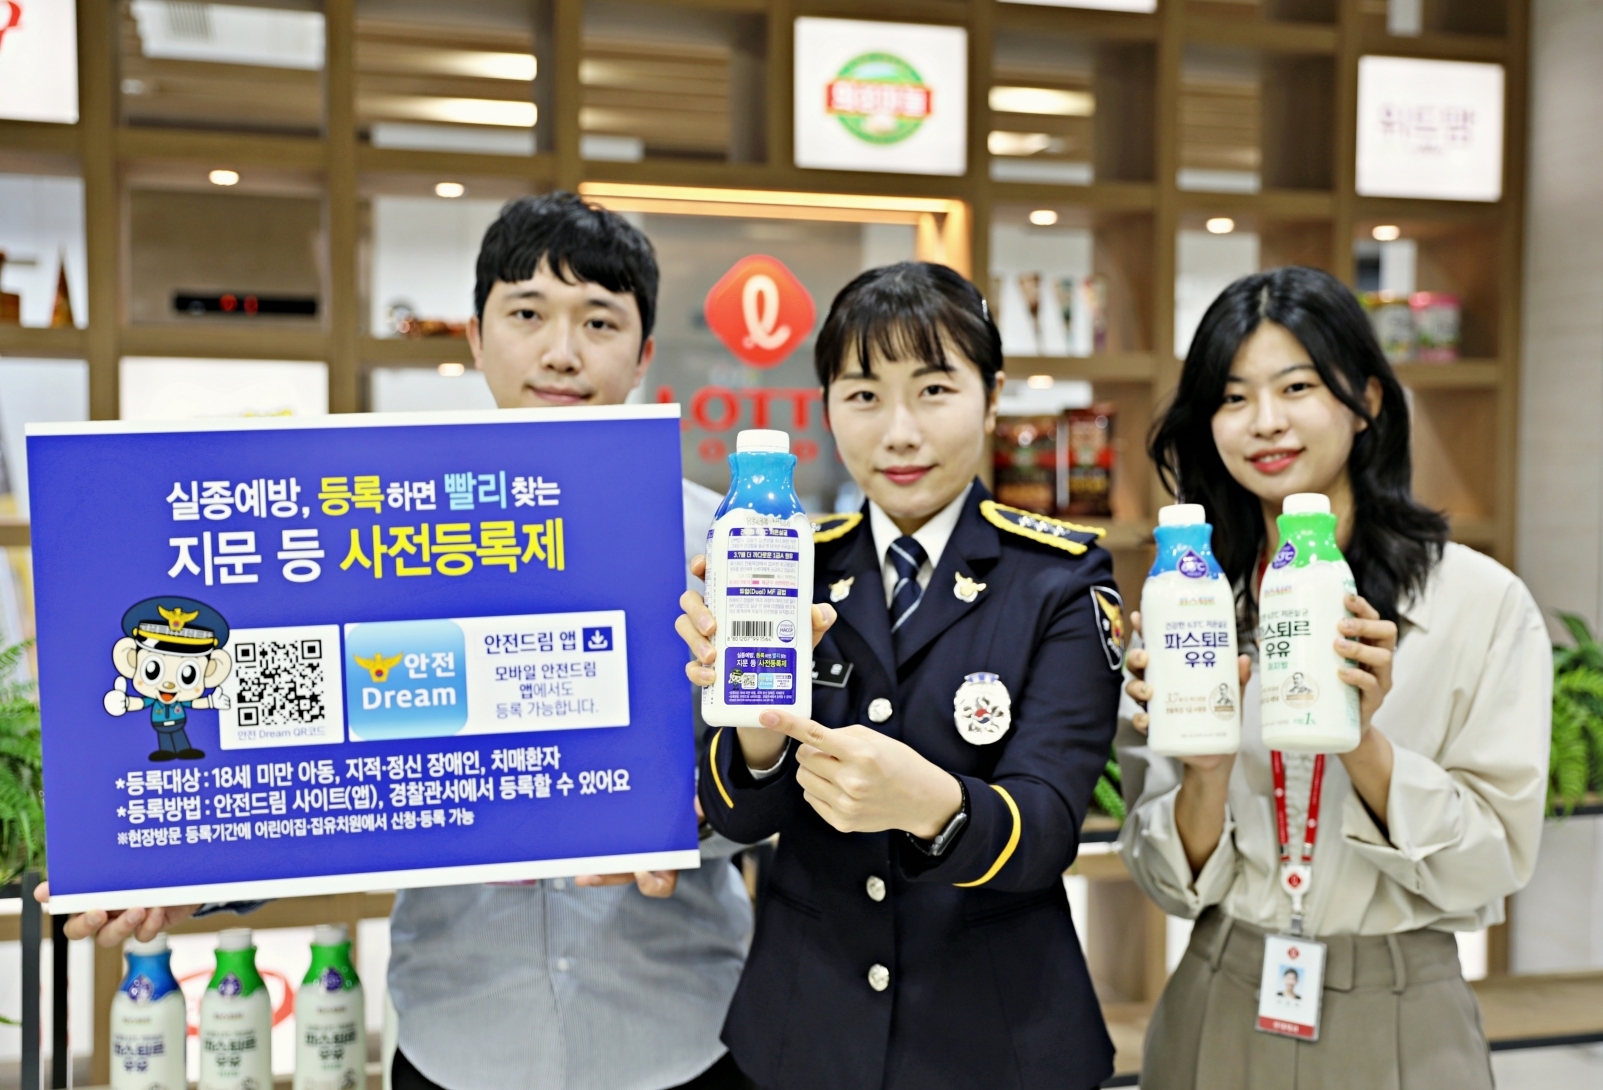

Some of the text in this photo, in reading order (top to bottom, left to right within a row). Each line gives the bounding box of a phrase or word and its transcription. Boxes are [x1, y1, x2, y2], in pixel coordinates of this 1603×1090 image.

[655, 384, 832, 432] OTT
[166, 477, 310, 521] 실종예방,
[444, 470, 507, 511] 빨리
[511, 476, 561, 508] 찾는
[167, 517, 565, 586] 지문 등 사전등록제
[484, 630, 577, 655] 안전드림 앱
[1164, 632, 1230, 650] 파스퇴르
[1264, 640, 1291, 660] 우유
[404, 652, 456, 679] 안전
[495, 661, 597, 682] 모바일 안전드림
[1184, 651, 1217, 668] 우유
[361, 686, 457, 710] Dream
[519, 681, 574, 699] 앱에서도
[495, 698, 600, 720] 등록 가능합니다.
[237, 726, 326, 741] 안전 Dream QR코드
[256, 761, 294, 787] 미만
[297, 759, 341, 785] 아동,
[426, 750, 486, 777] 장애인,
[490, 745, 562, 773] 치매환자
[292, 783, 385, 813] 사이트(앱),
[388, 777, 495, 807] 경찰관서에서
[499, 773, 552, 800] 등록할
[555, 771, 575, 796] 수
[578, 769, 631, 796] 있어요
[185, 822, 252, 844] 등록기간에
[448, 807, 475, 826] 가능
